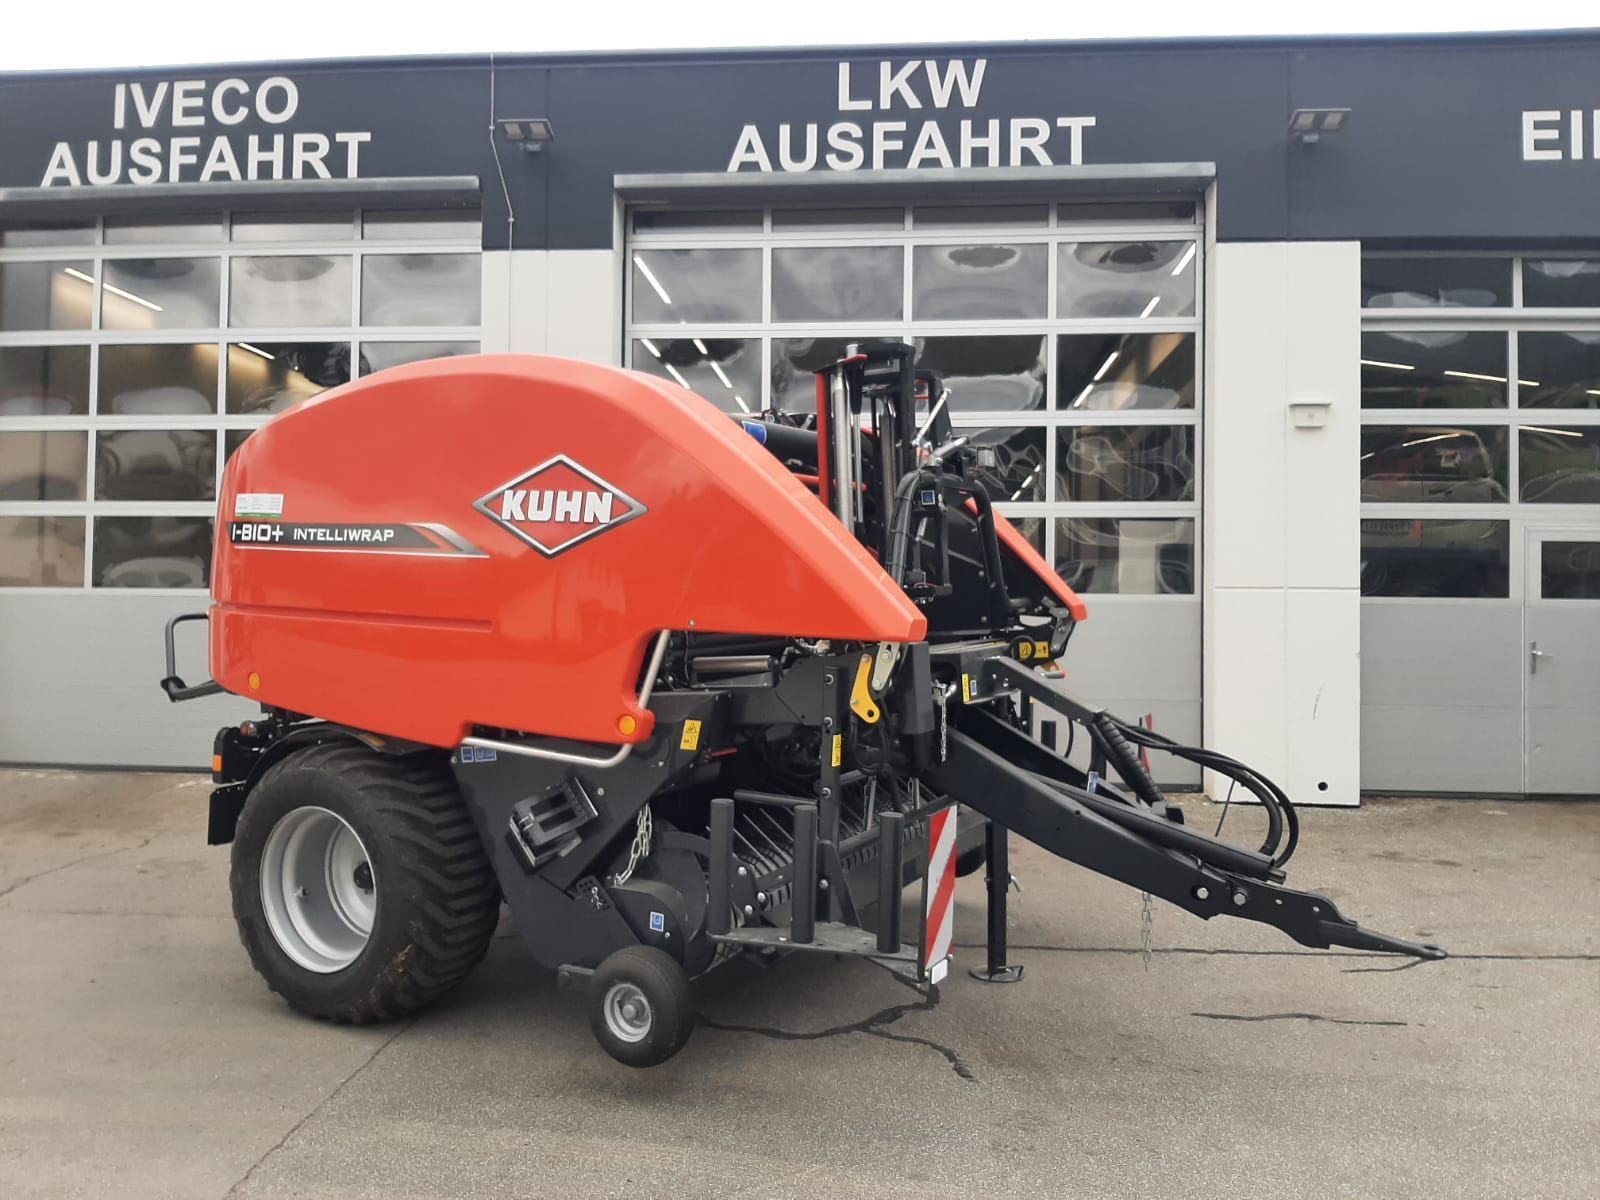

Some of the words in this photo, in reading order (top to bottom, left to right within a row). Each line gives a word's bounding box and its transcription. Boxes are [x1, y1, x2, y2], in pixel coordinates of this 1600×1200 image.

[113, 76, 299, 129] IVECO
[838, 59, 987, 110] LKW
[40, 132, 371, 187] AUSFAHRT
[727, 117, 1096, 172] AUSFAHRT
[1522, 109, 1600, 160] EI
[501, 490, 613, 524] KUHN
[293, 527, 395, 542] INTELLIWRAP
